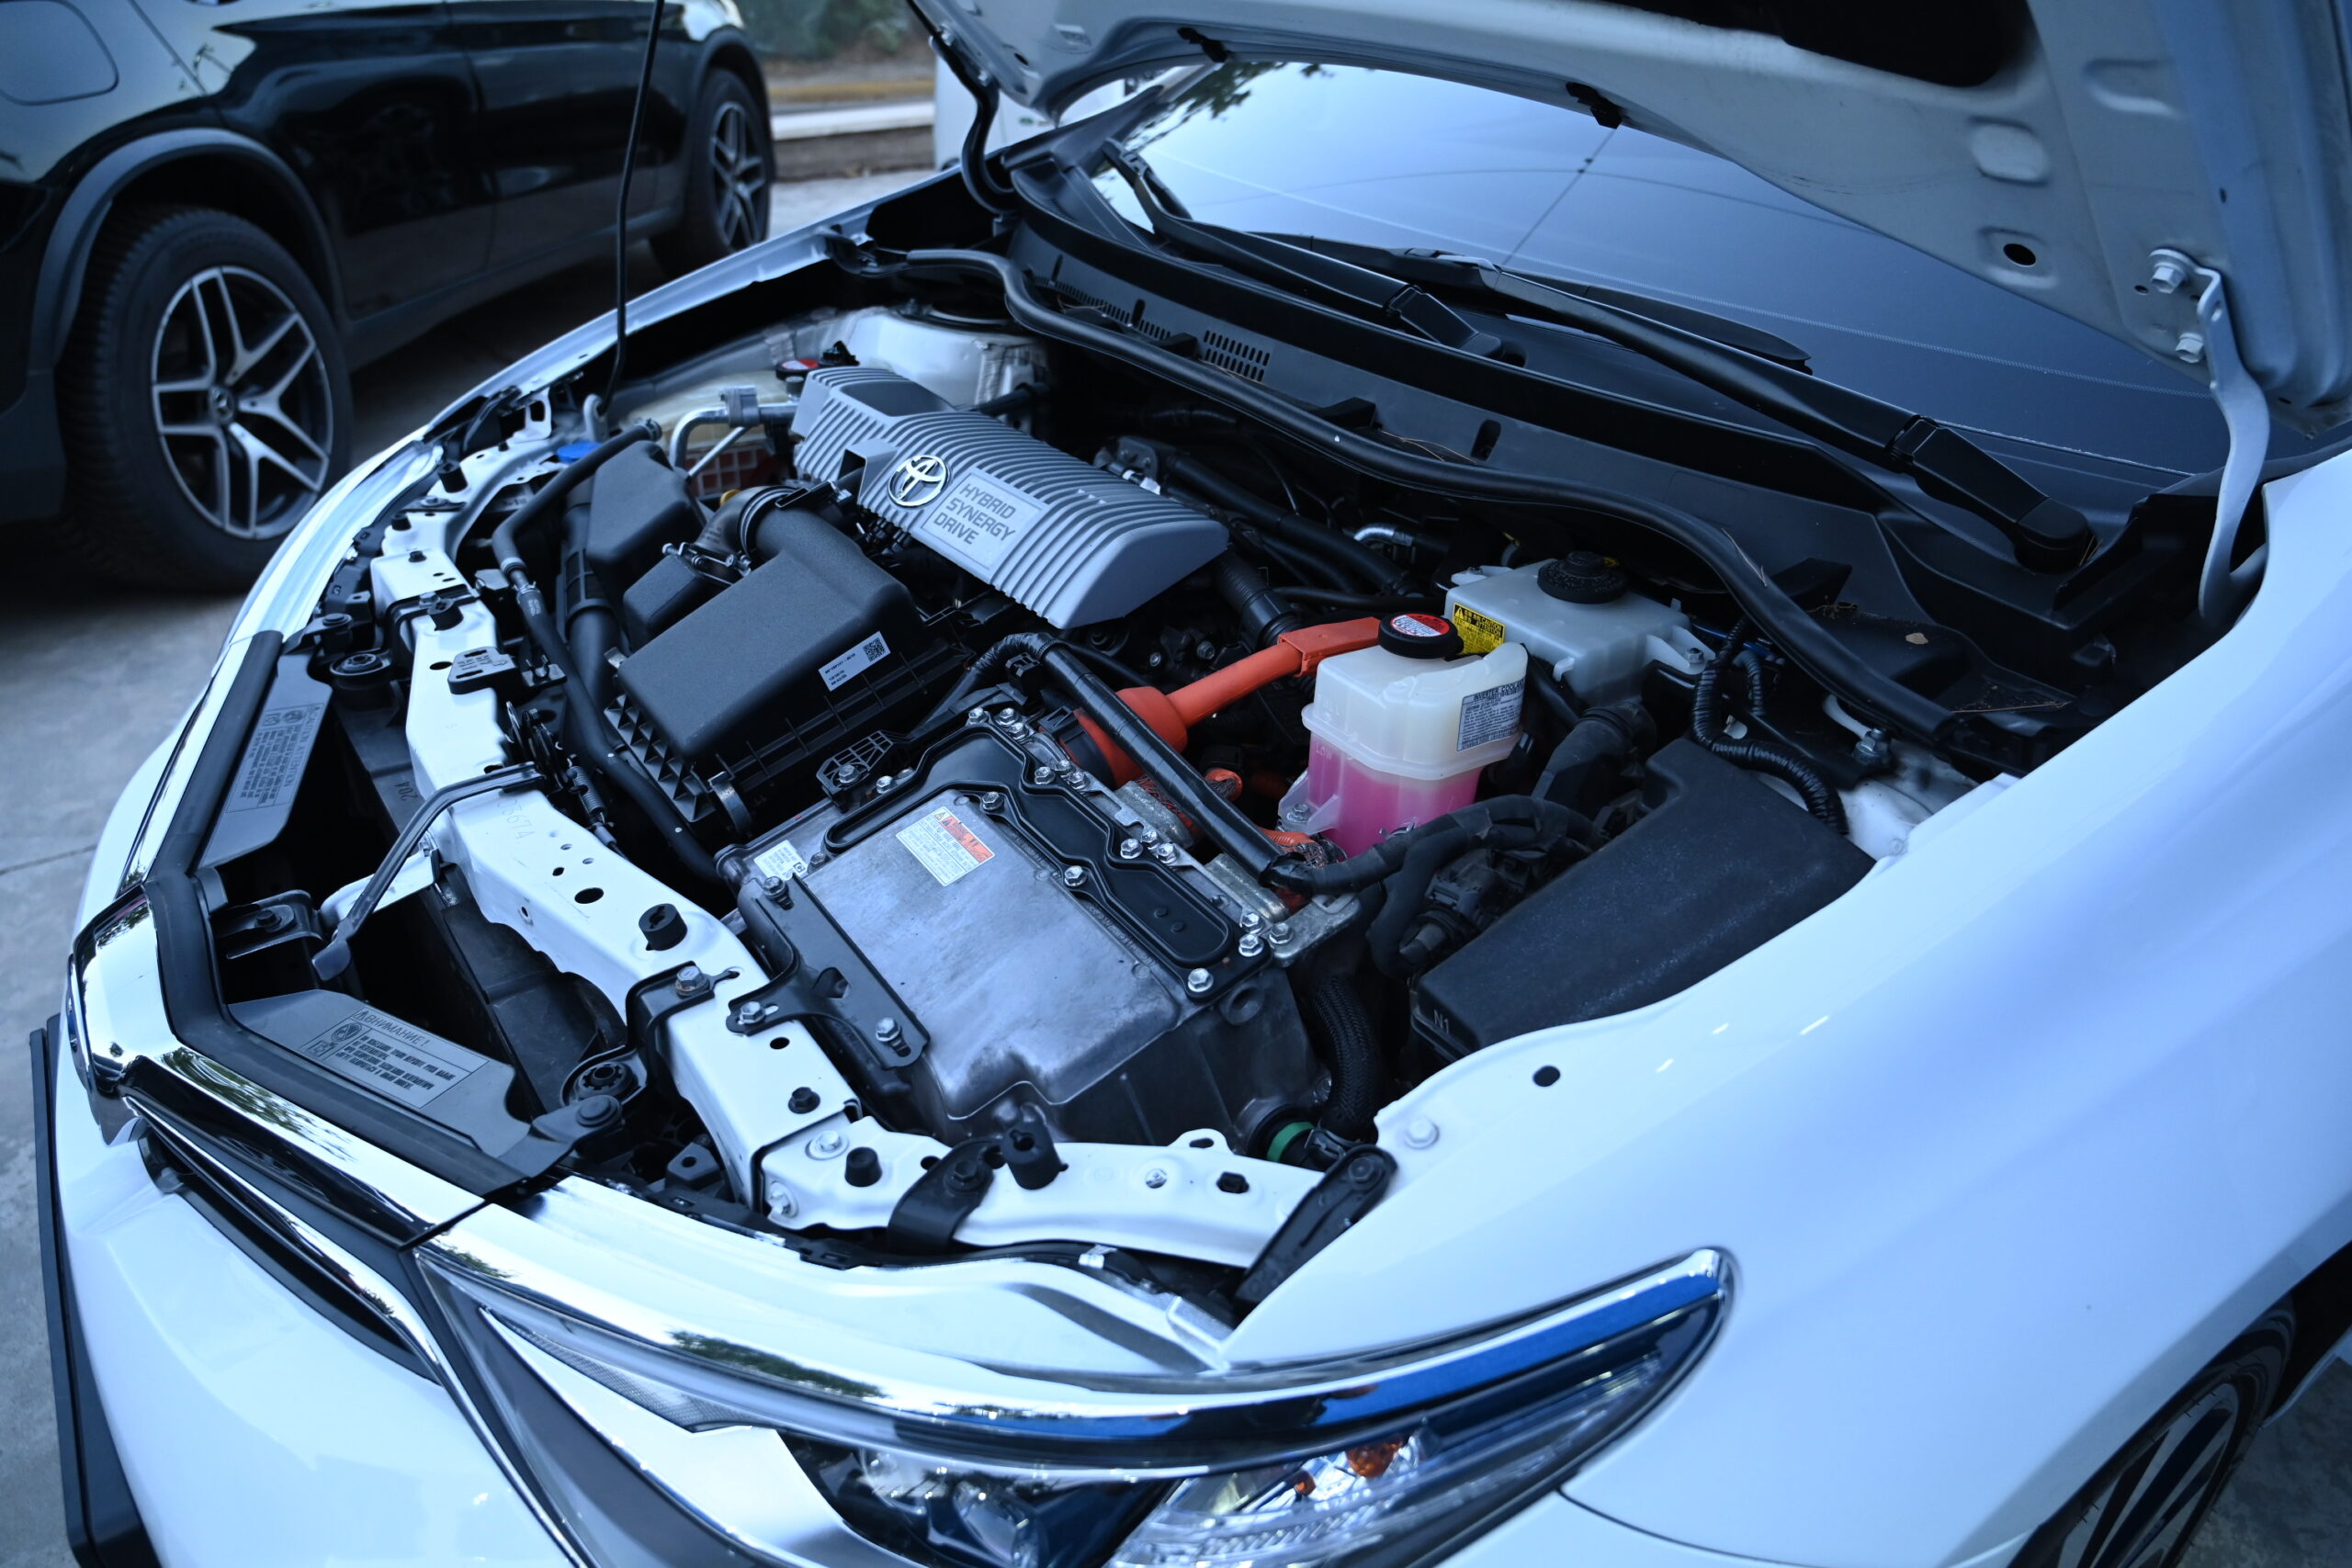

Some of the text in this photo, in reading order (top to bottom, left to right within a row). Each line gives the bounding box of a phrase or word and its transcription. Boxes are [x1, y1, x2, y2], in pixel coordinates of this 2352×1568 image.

[959, 483, 1016, 519] HYBRID
[933, 512, 979, 545] DRIVE
[945, 499, 1016, 541] SYNERGY
[1474, 688, 1498, 702] INVERTER
[1434, 1010, 1449, 1034] N1
